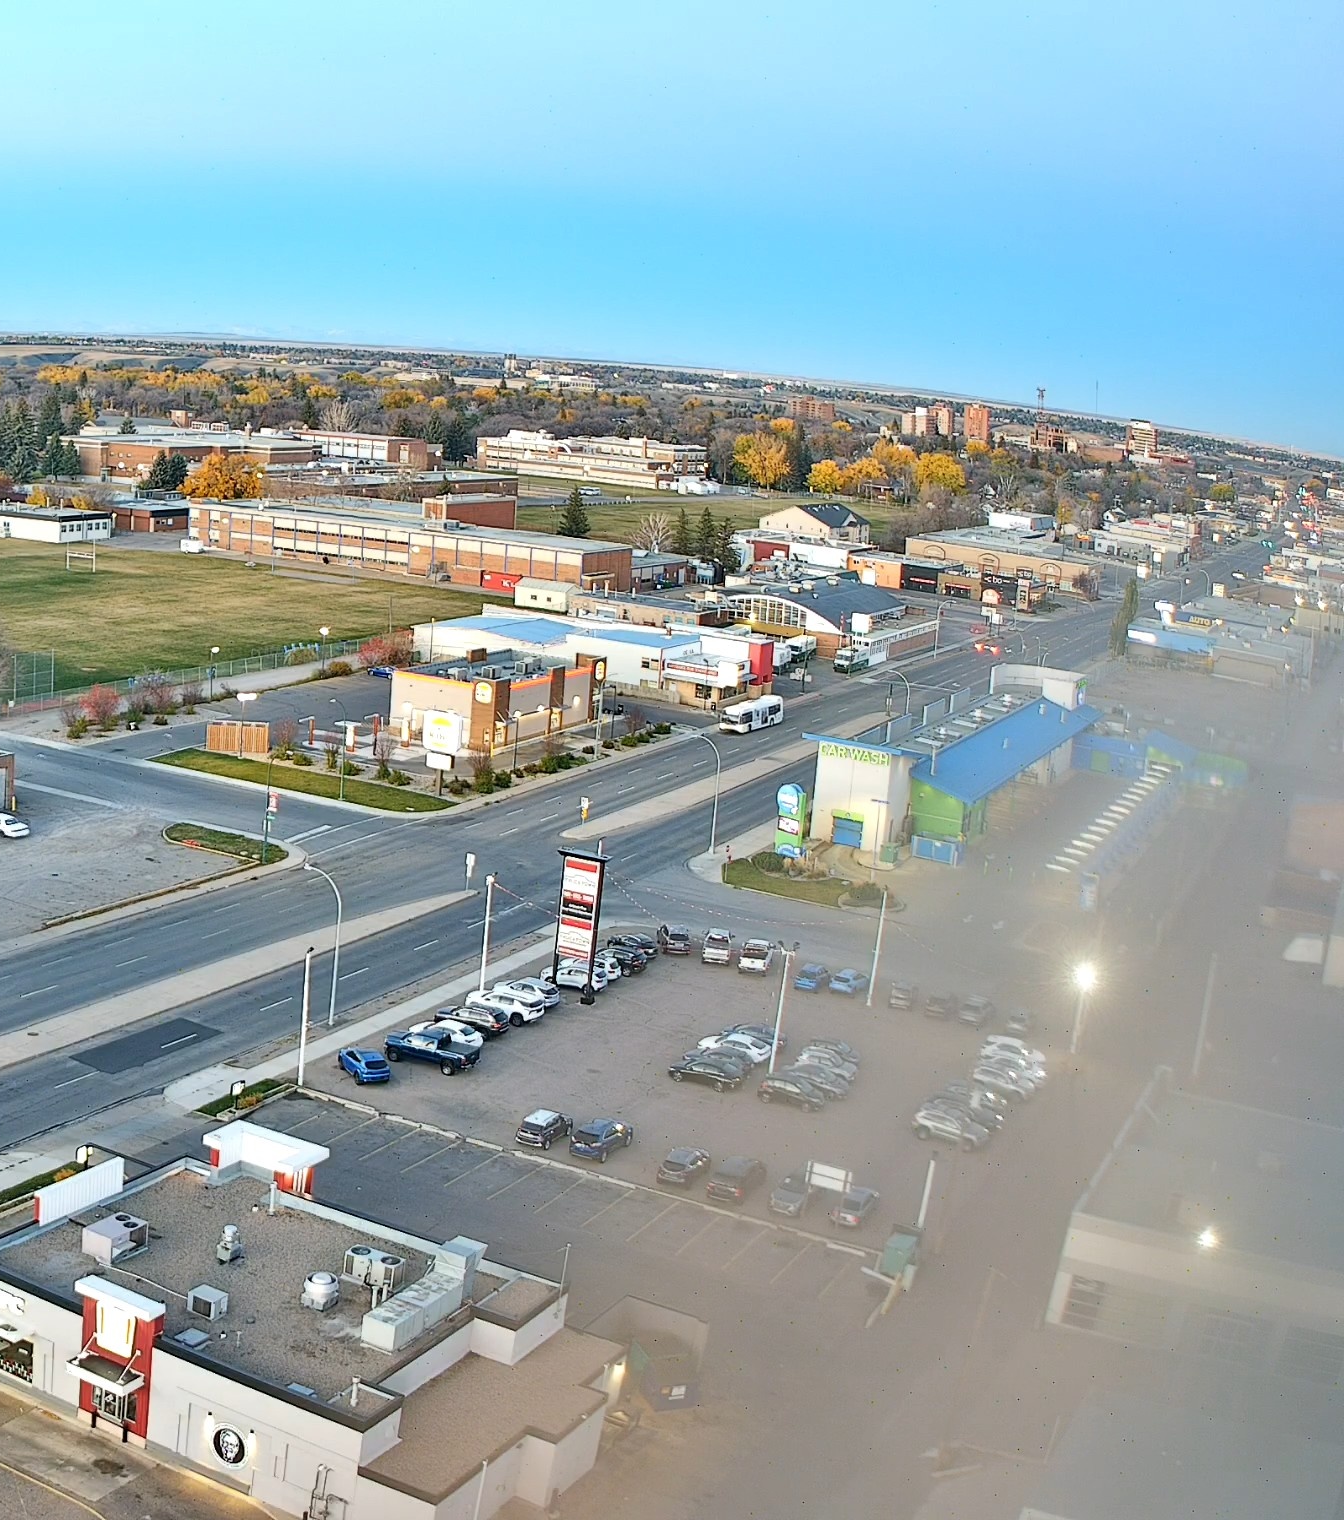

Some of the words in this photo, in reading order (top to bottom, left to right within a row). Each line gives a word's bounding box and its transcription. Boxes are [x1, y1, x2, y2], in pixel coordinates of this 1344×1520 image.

[1188, 615, 1211, 626] AUTO
[820, 744, 848, 759] CAR
[850, 748, 890, 766] WASH
